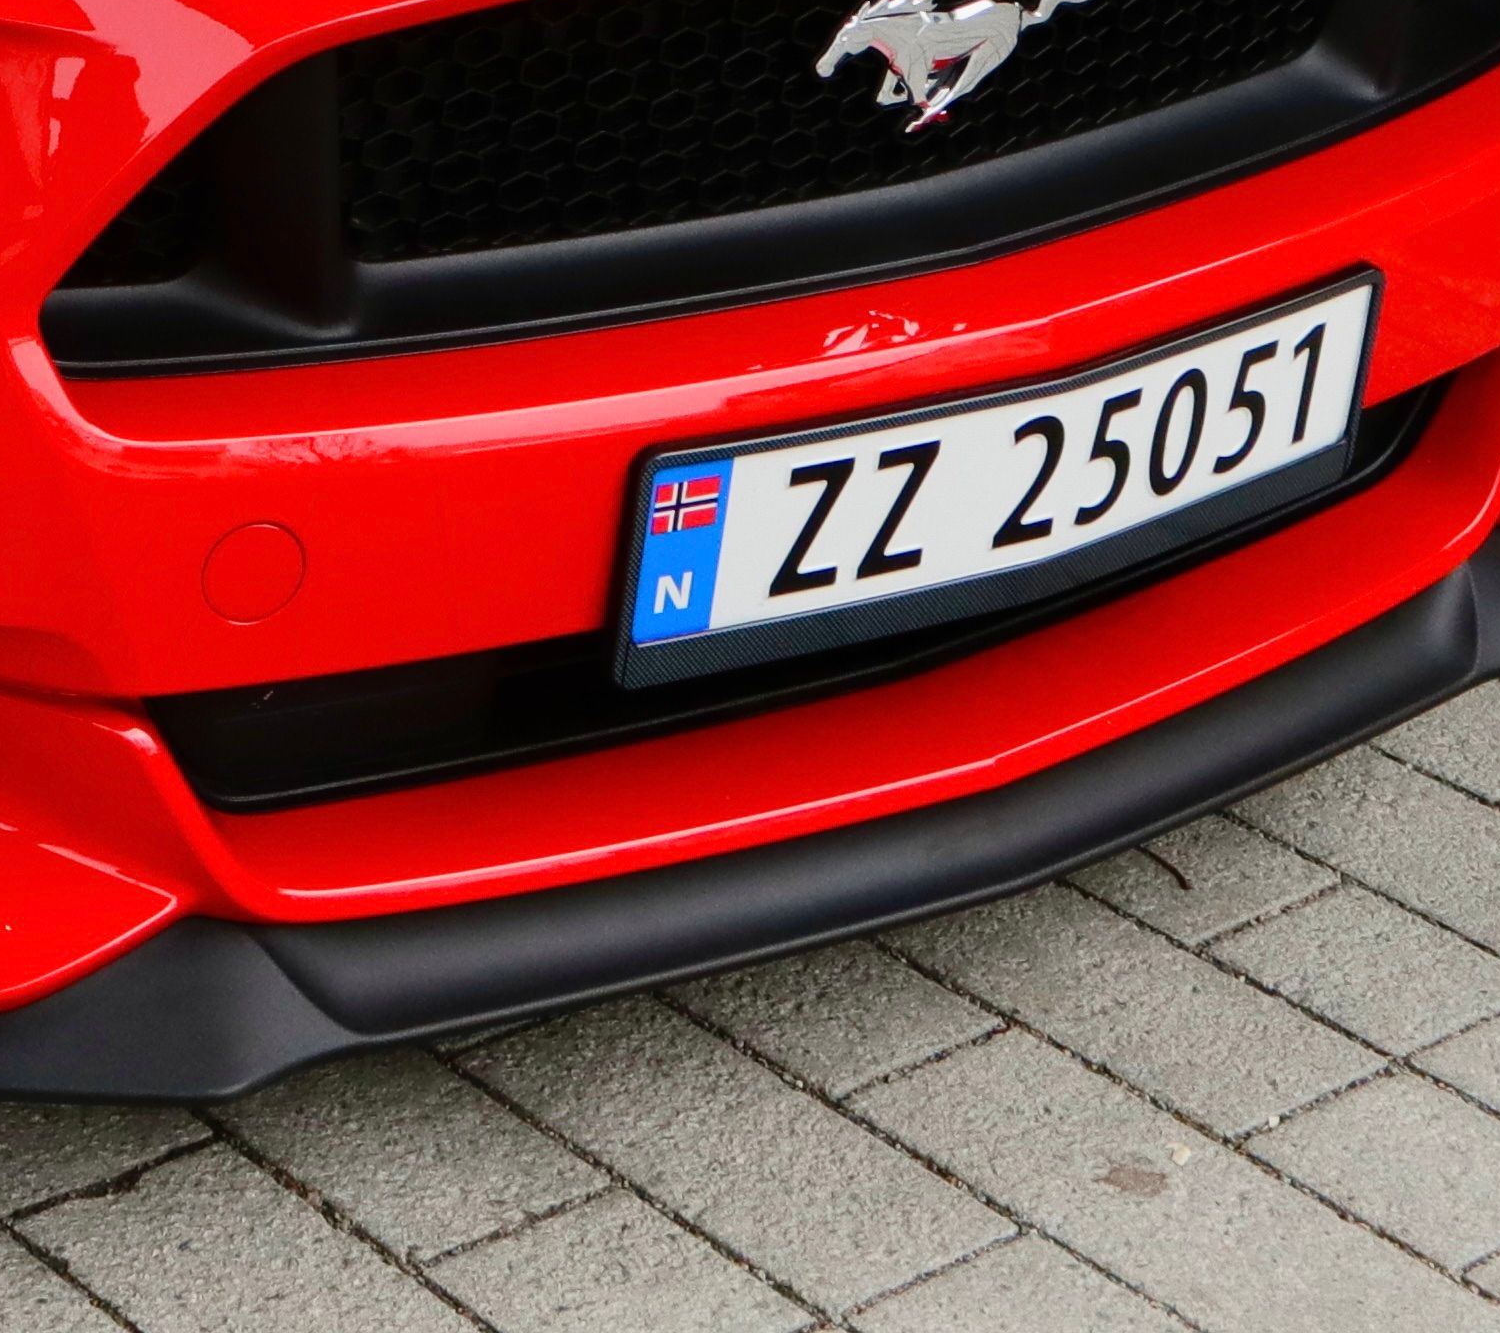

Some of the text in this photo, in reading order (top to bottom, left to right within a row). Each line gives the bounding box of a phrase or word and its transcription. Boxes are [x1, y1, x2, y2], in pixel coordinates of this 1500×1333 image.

[768, 322, 1330, 599] ZZ 25051
[653, 573, 692, 615] N
